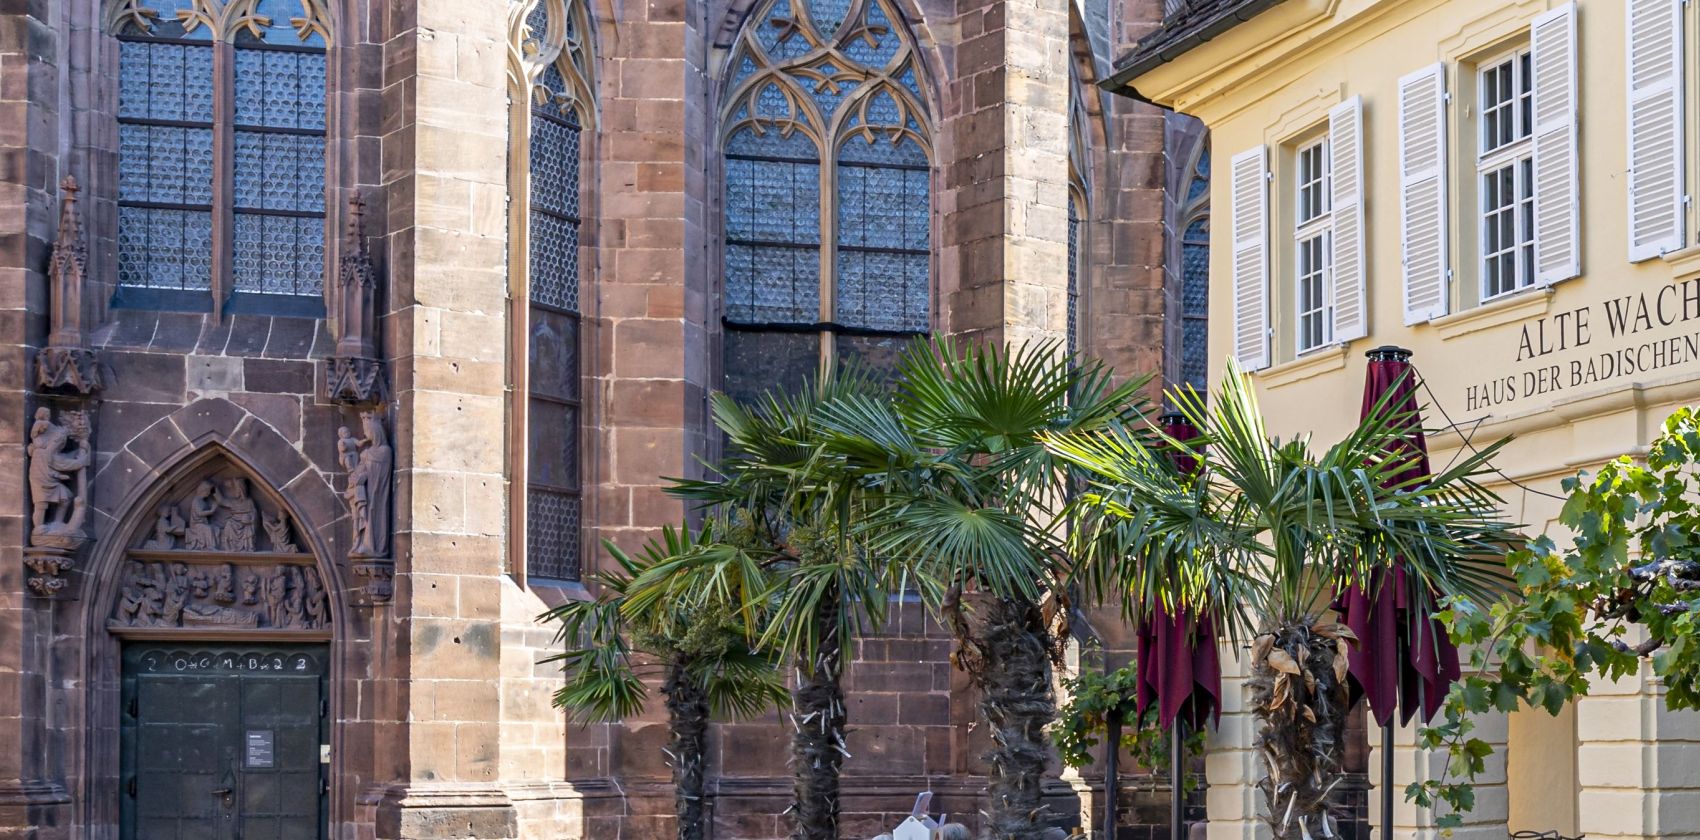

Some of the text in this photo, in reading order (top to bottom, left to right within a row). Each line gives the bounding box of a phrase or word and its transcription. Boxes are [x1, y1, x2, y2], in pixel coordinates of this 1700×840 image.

[1516, 305, 1592, 362] ALTE
[1466, 376, 1516, 412] HAUS
[1523, 364, 1562, 398] DER
[1569, 332, 1700, 387] BADISCHEN
